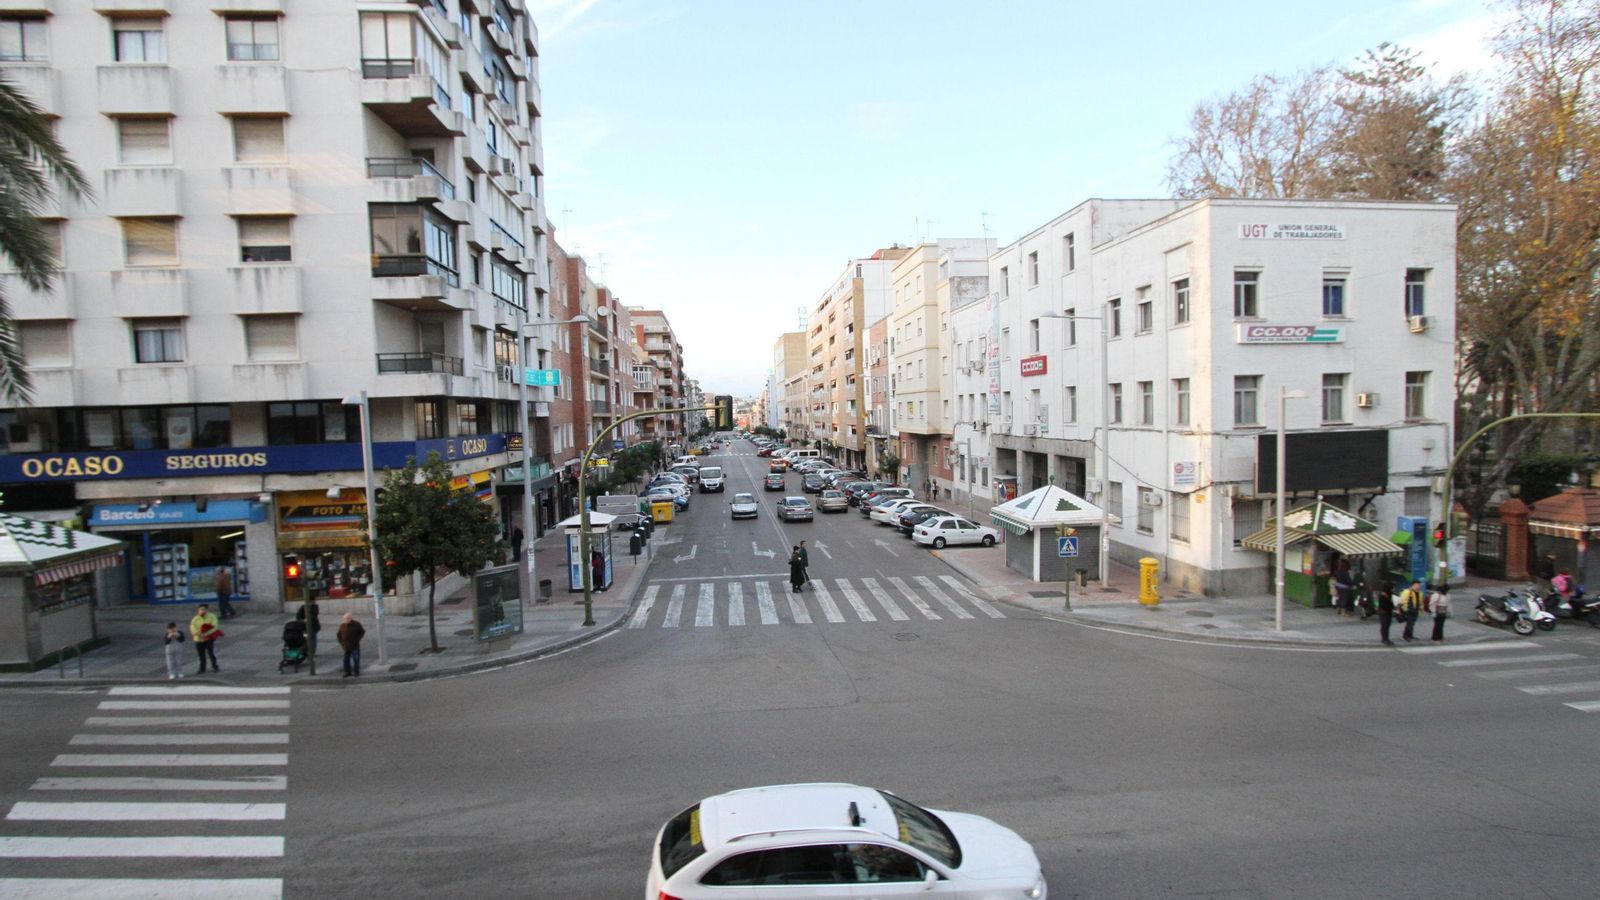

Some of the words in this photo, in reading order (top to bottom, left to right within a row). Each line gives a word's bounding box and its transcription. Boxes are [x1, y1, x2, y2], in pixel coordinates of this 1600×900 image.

[1243, 224, 1268, 237] UGT
[462, 438, 487, 455] OCASO
[22, 455, 124, 478] OCASO
[166, 452, 268, 470] SEGUROS
[312, 506, 344, 515] FOTO
